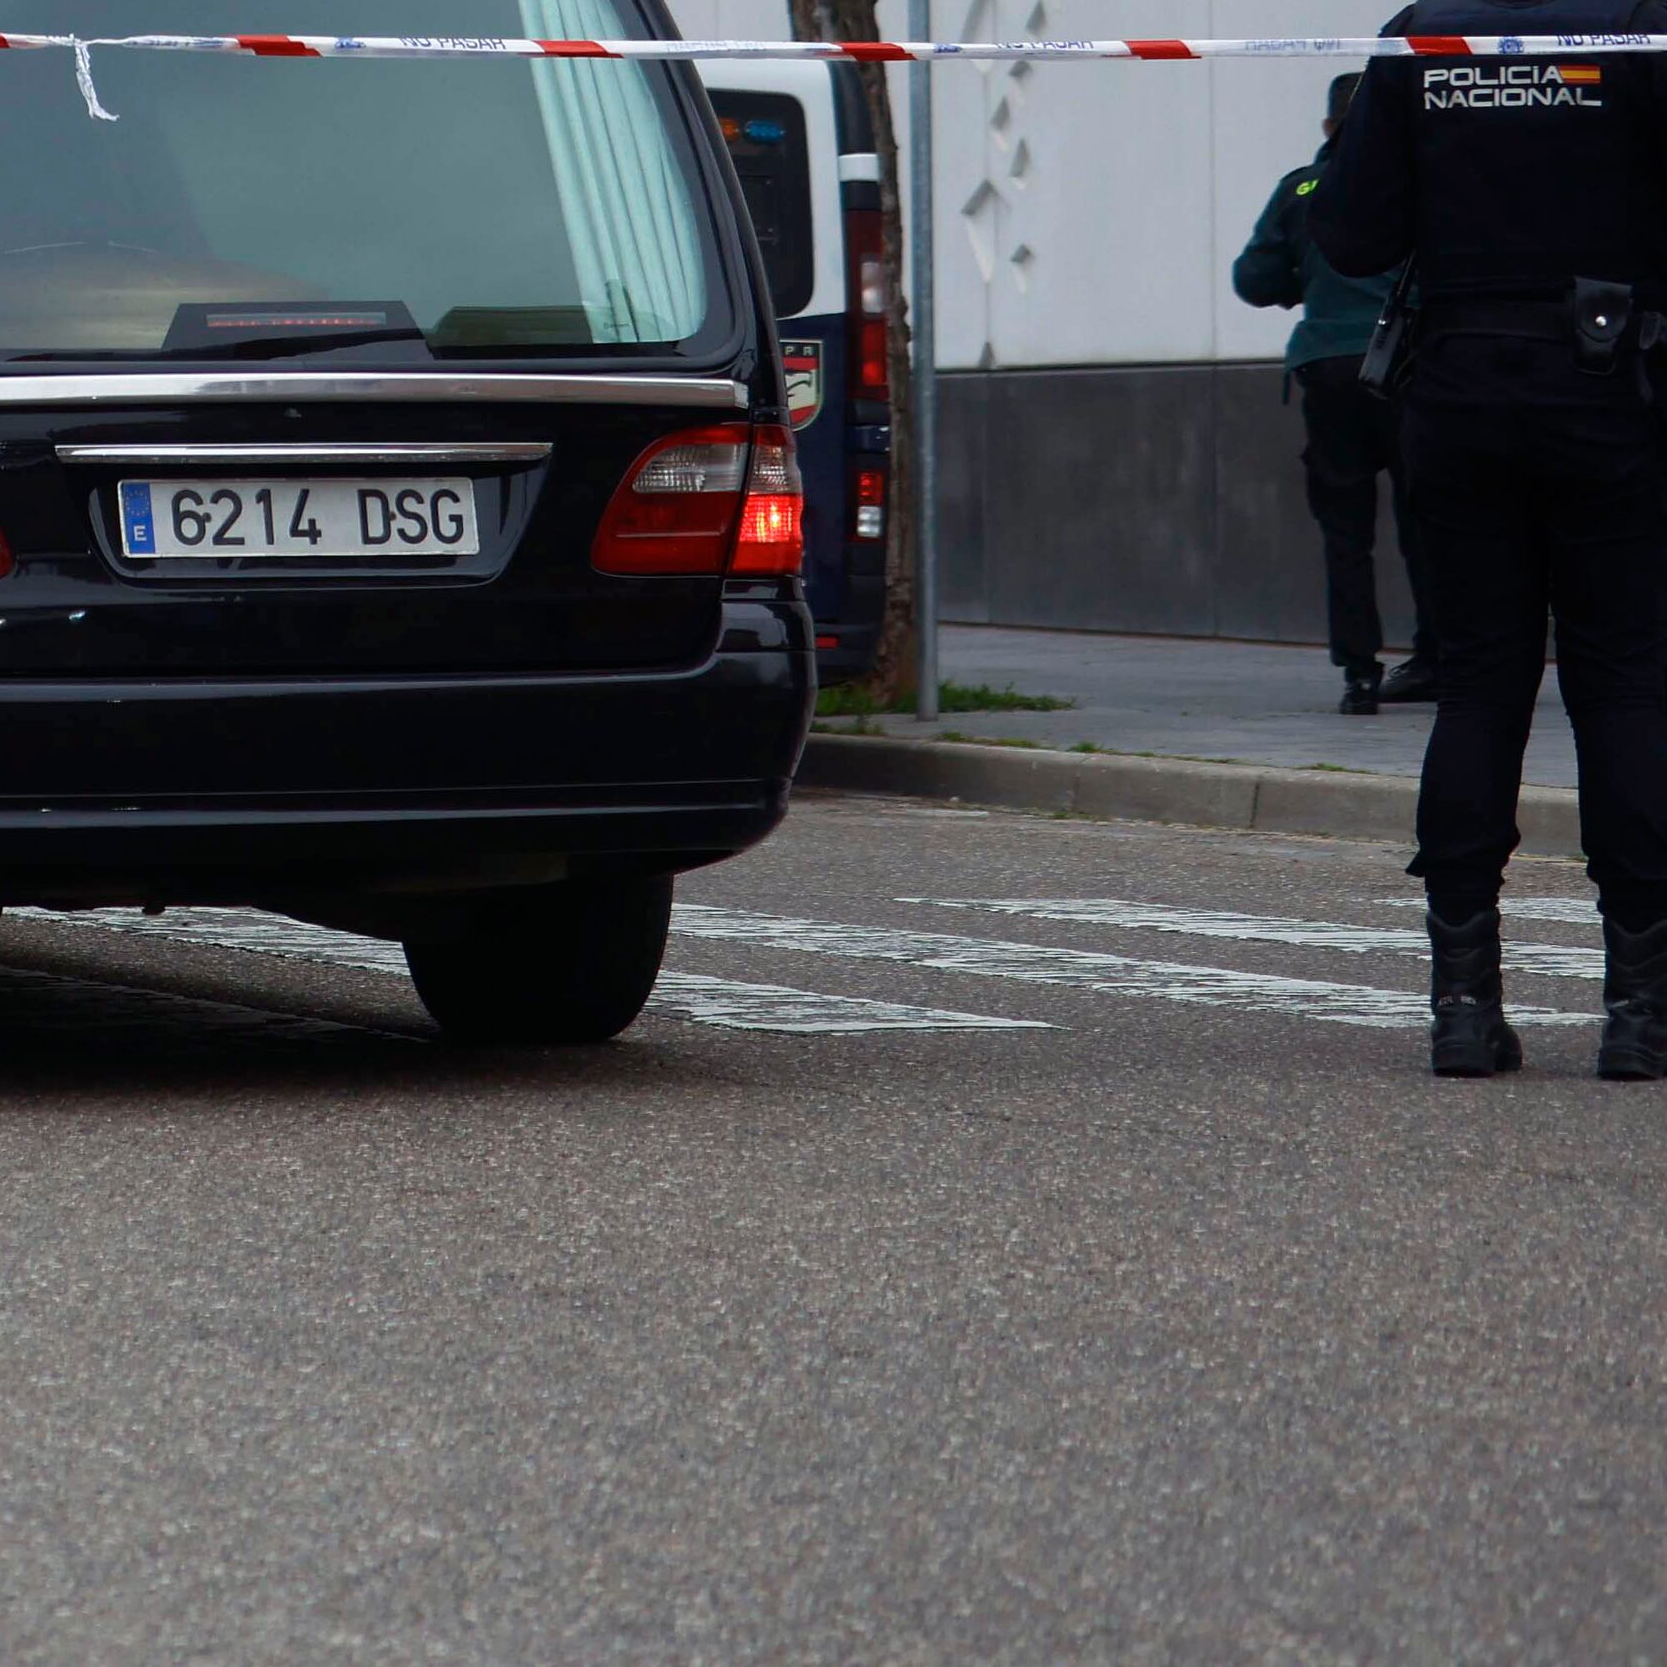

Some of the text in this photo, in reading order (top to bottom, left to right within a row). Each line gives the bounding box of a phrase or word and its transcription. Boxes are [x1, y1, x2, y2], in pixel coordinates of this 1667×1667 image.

[1424, 87, 1602, 110] NACIONAL
[133, 489, 464, 546] E 6214 DSG
